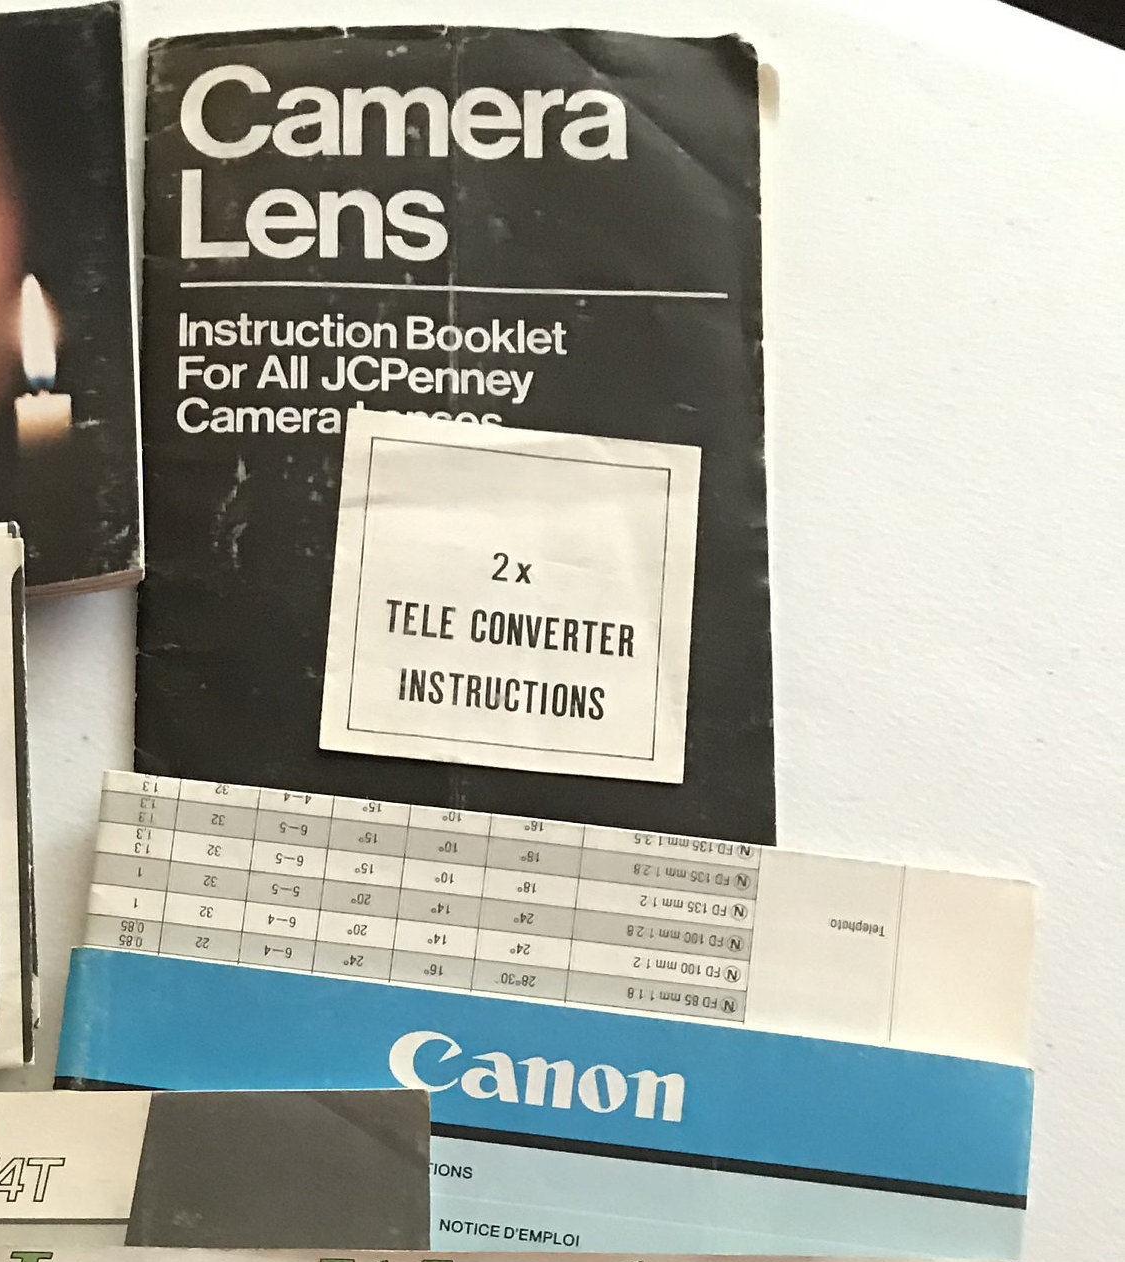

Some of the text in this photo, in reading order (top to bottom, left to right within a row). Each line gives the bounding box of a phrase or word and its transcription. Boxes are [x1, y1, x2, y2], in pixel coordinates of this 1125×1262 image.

[180, 64, 628, 160] Camera
[180, 168, 449, 262] Lens
[179, 313, 567, 355] Instruction Booklet
[178, 356, 534, 405] For All JCPenney
[176, 398, 341, 434] Camera
[386, 599, 635, 658] TELE CONVERTER
[399, 668, 606, 721] INSTRUCTIONS
[215, 784, 229, 794] 32
[212, 814, 225, 826] 32
[668, 838, 689, 848] mm
[693, 840, 713, 853] 135
[208, 845, 221, 856] 32
[718, 845, 732, 855] FD
[666, 868, 686, 878] mm
[204, 875, 218, 887] 32
[663, 898, 683, 908] mm
[688, 901, 707, 914] 135
[200, 906, 213, 918] 32
[712, 904, 726, 916] FD
[830, 919, 885, 937] Telephoto
[659, 930, 680, 939] mm
[196, 937, 210, 948] 22
[709, 935, 724, 947] FD
[656, 960, 676, 970] mm
[681, 963, 701, 975] 100
[706, 966, 720, 977] FD
[660, 991, 681, 1001] mm
[703, 996, 717, 1008] FD
[389, 1031, 686, 1123] Canon
[439, 1219, 580, 1247] NOTICE D'EMPLOI
